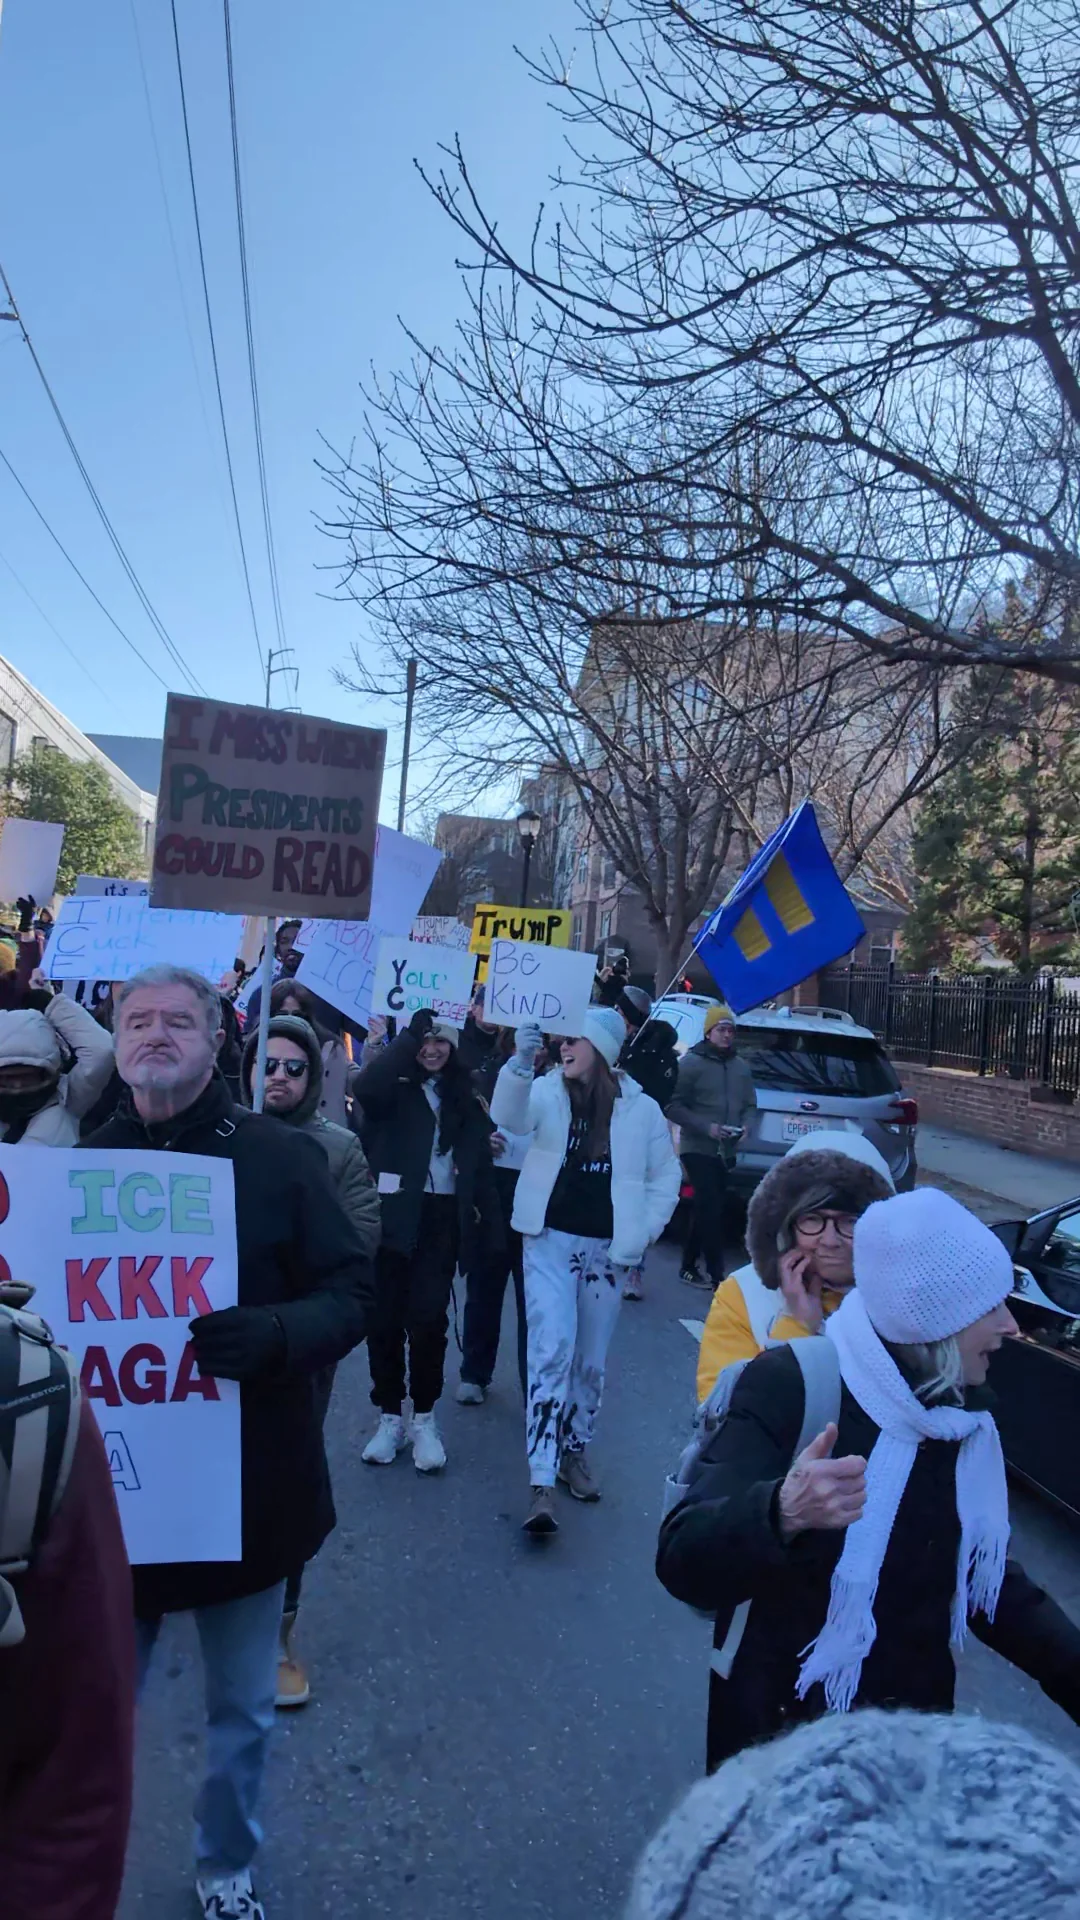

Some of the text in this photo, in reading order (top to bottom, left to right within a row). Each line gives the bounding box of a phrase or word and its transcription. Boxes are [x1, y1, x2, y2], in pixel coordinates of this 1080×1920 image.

[168, 699, 379, 771] I MISS WHEN
[155, 833, 265, 879] COULD
[272, 836, 373, 897] READ
[416, 917, 450, 929] TRUMP
[68, 1169, 214, 1235] ICE
[65, 1256, 214, 1323] KKK
[60, 1342, 221, 1407] AGA
